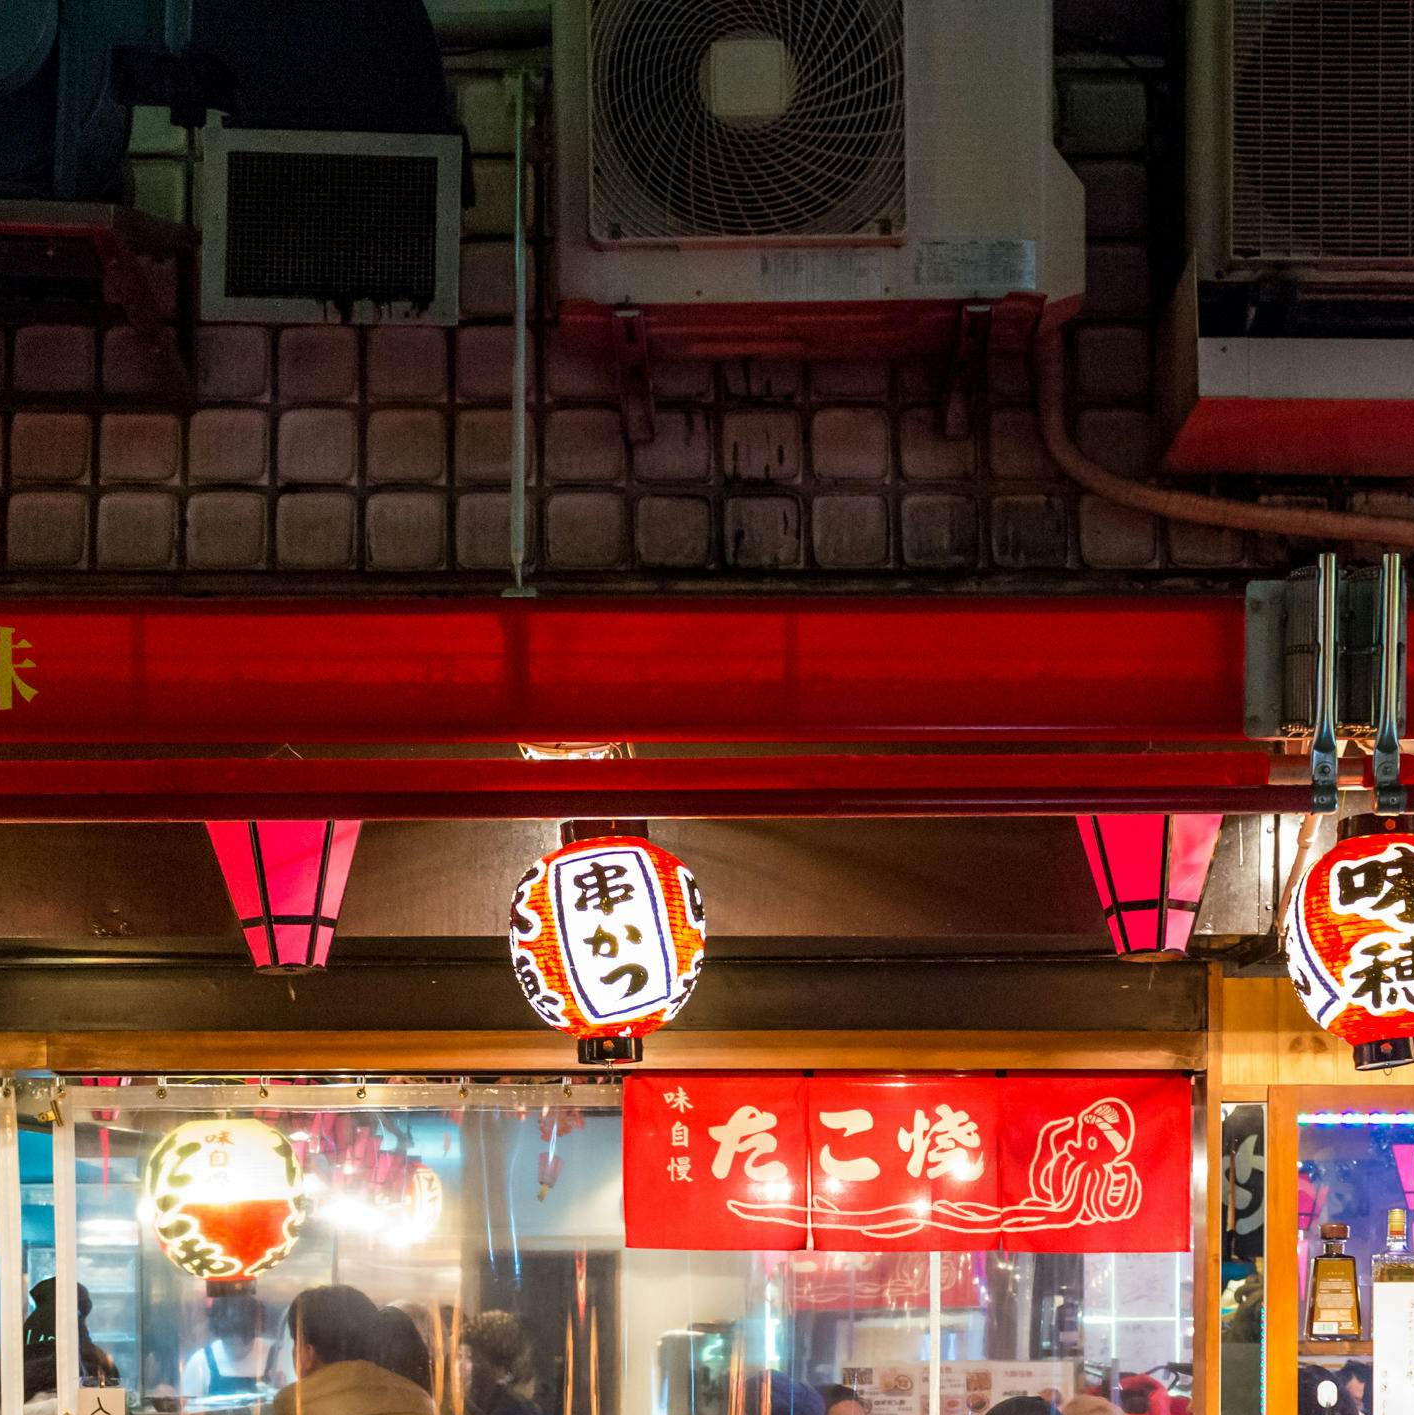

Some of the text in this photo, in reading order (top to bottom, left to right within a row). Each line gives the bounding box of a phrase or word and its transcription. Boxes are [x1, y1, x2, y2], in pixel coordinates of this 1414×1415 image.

[573, 861, 649, 1000] 串かつ
[663, 1086, 694, 1183] 味自慢
[708, 1104, 985, 1182] たこ焼
